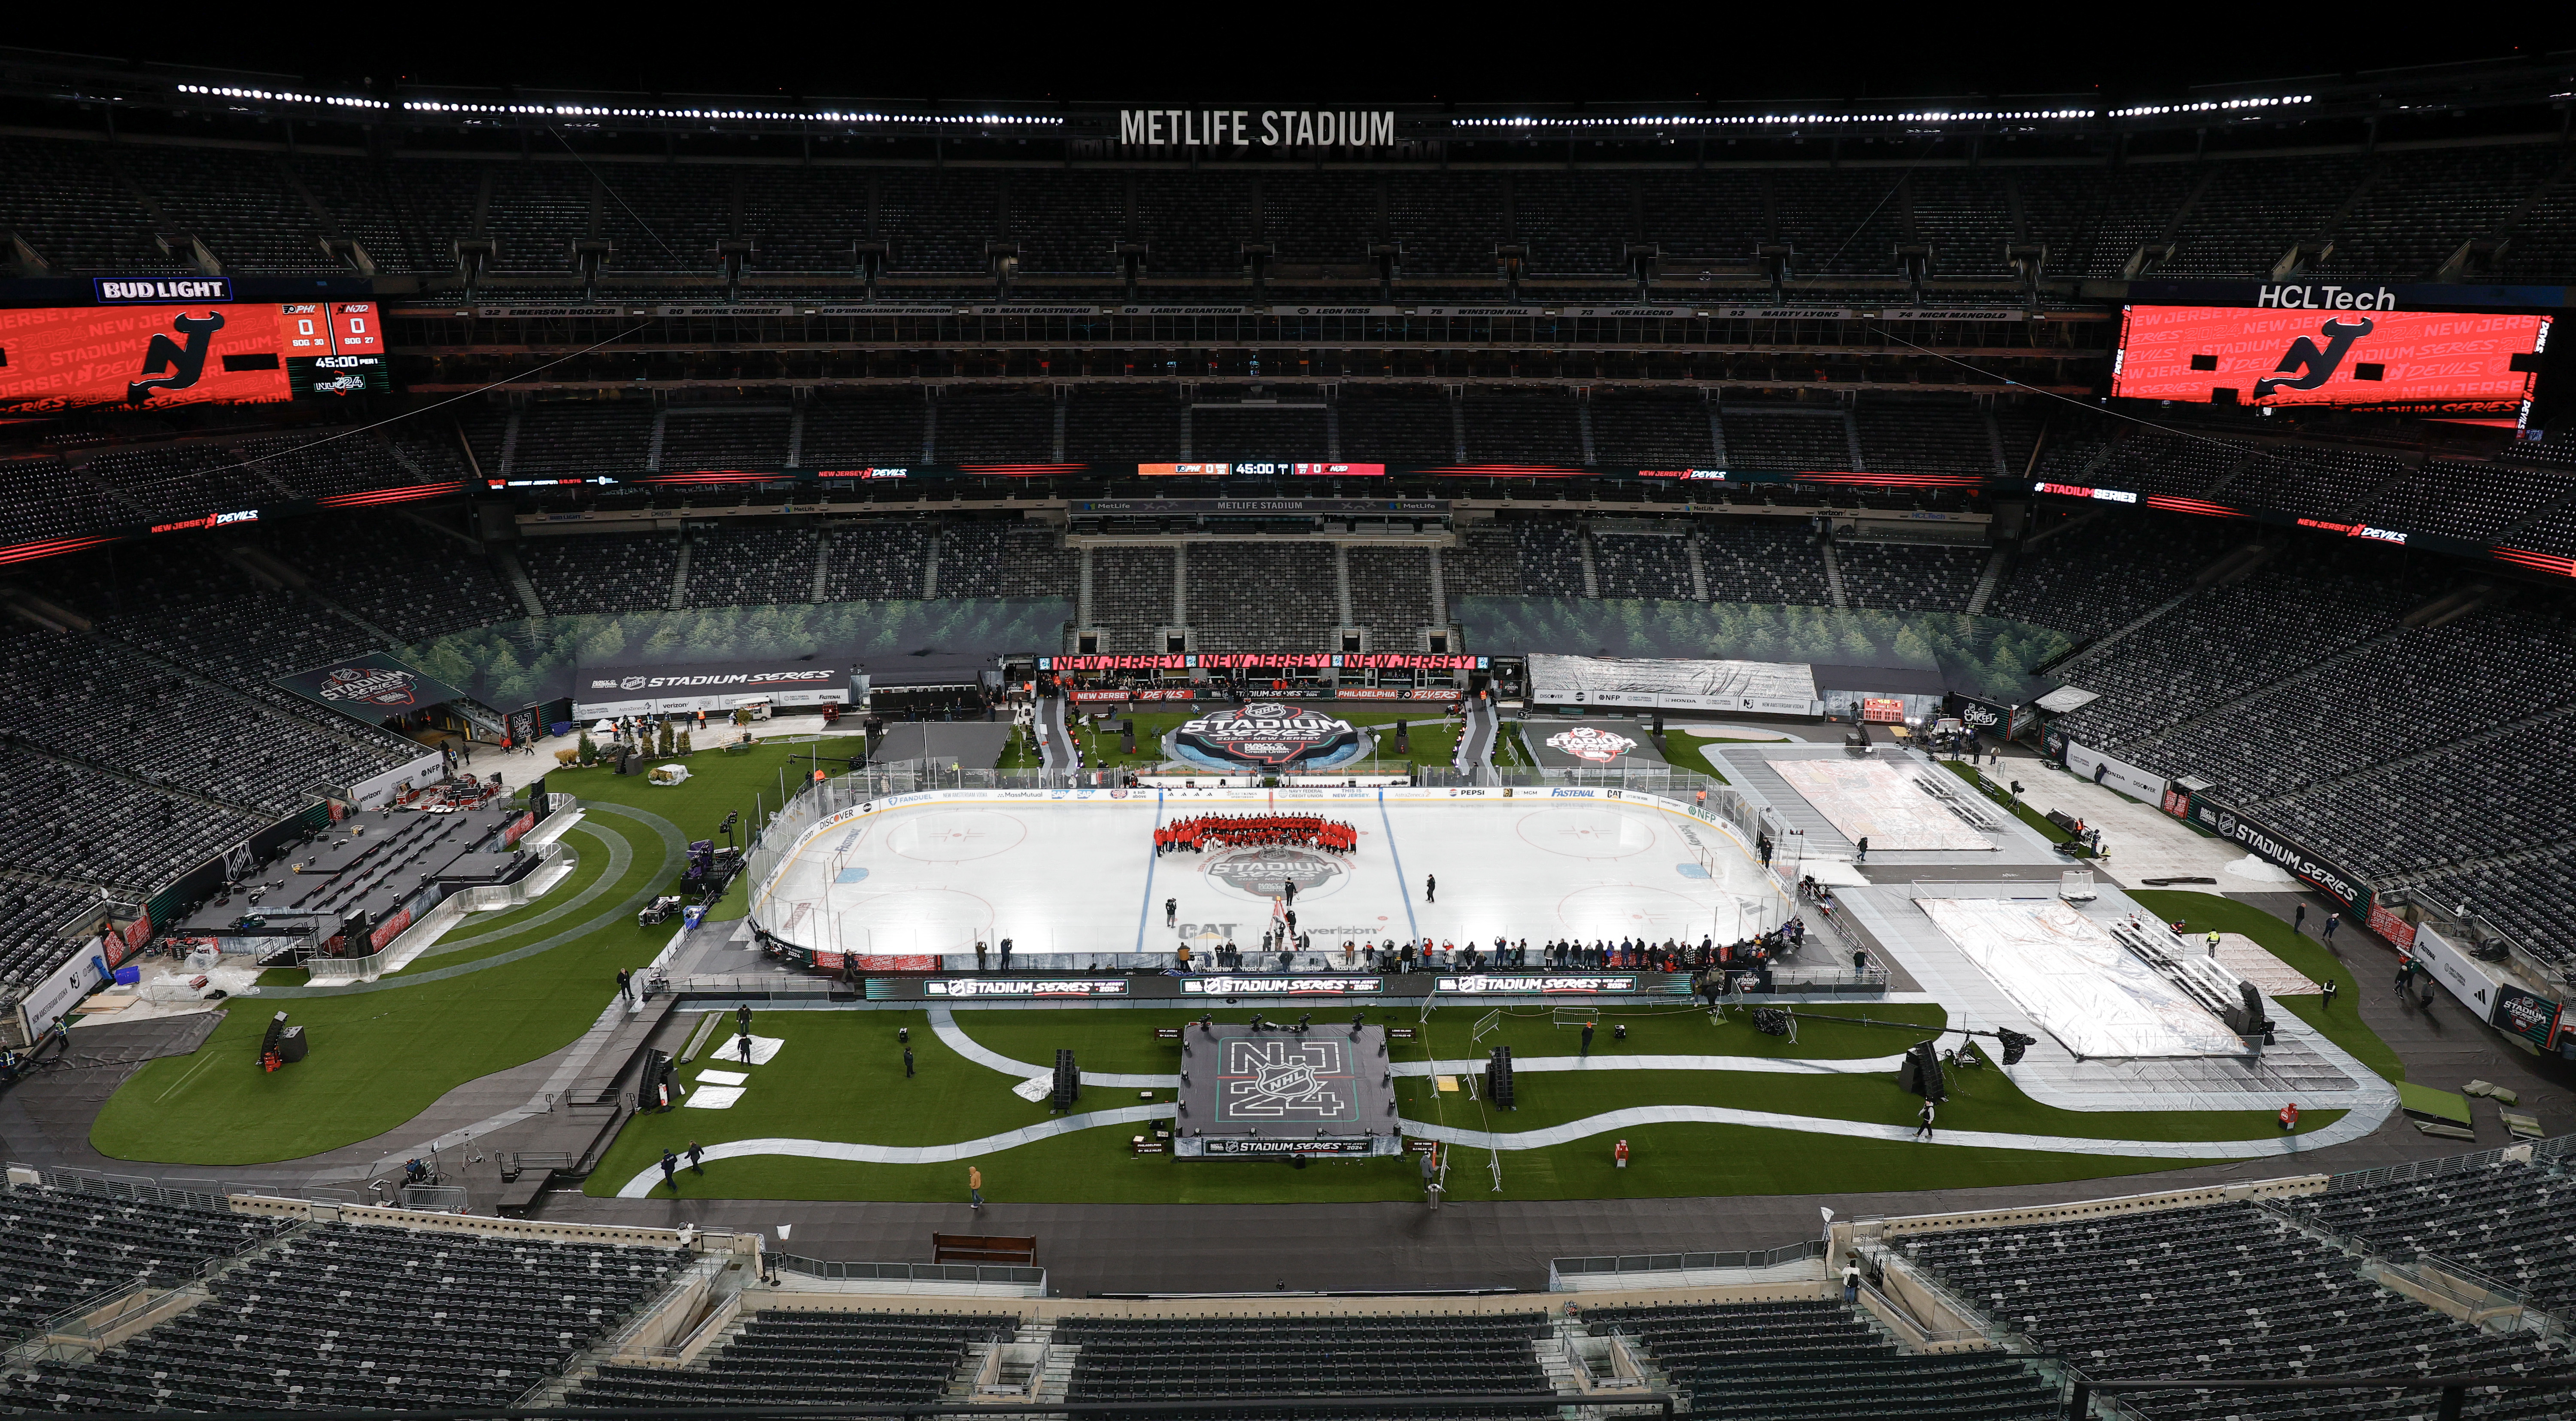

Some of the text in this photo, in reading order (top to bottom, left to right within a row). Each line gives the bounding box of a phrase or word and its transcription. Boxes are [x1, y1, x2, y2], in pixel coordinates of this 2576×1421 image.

[1121, 110, 1394, 146] METLIFE STADIUM
[103, 281, 223, 299] BUD LIGHT
[2258, 285, 2396, 310] HCLTech
[89, 318, 134, 337] NEW
[298, 319, 314, 335] 0
[350, 318, 366, 334] 0
[2243, 317, 2288, 334] NEW
[2424, 321, 2473, 337] NEW
[2536, 321, 2550, 353] DEVILS
[50, 338, 137, 366] STADIUM
[2416, 339, 2498, 356] SERIES
[316, 356, 358, 368] 45:00
[2406, 362, 2483, 377] DEVILS
[872, 469, 906, 477] DEVILS
[1236, 464, 1274, 474] 45:00
[1691, 470, 1725, 478] DEVILS
[2034, 482, 2137, 503] #STADIUMSERIES
[1218, 501, 1303, 510] METLIFE STADIUM
[152, 510, 258, 533] NEW JERSEY DEVILS
[1912, 512, 1945, 520] HCLTech
[2297, 518, 2407, 542] NEW JERSEY DEVILS
[319, 670, 415, 701] STADIUM
[648, 670, 834, 687] STADIUM SERIES
[347, 679, 403, 699] SERIES
[1414, 691, 1460, 699] FLYERS
[1255, 706, 1278, 715] NHL
[1964, 709, 1996, 724] STREET
[1181, 719, 1353, 734] STADIUM
[427, 764, 440, 774] NFP
[899, 794, 933, 803] FANDUEL
[1551, 788, 1595, 797] FASTENAL
[1607, 789, 1622, 799] CAT
[820, 809, 854, 830] DISCOVER
[1697, 809, 1716, 823] NFP
[1678, 825, 1704, 846] betway
[232, 849, 246, 877] NHL
[782, 847, 796, 864] HONDA
[2236, 824, 2358, 902] STADIUM SERIES
[1211, 861, 1343, 875] STADIUM
[1307, 926, 1377, 935] verizon
[788, 950, 801, 958] 2024
[966, 982, 1093, 993] STADIUM SERIES
[1222, 980, 1347, 992] STADIUM SERIES
[1476, 978, 1601, 989] STADIUM SERIES
[39, 997, 58, 1021] AMSTERDAM
[58, 988, 68, 1004] VODKA
[2503, 1001, 2546, 1024] STADIUM
[2509, 1009, 2540, 1023] SERIES
[1230, 1042, 1340, 1073] NJ
[1270, 1071, 1304, 1091] NHL
[1229, 1080, 1344, 1116] 24
[1239, 1142, 1342, 1151] STADIUM SERIES
